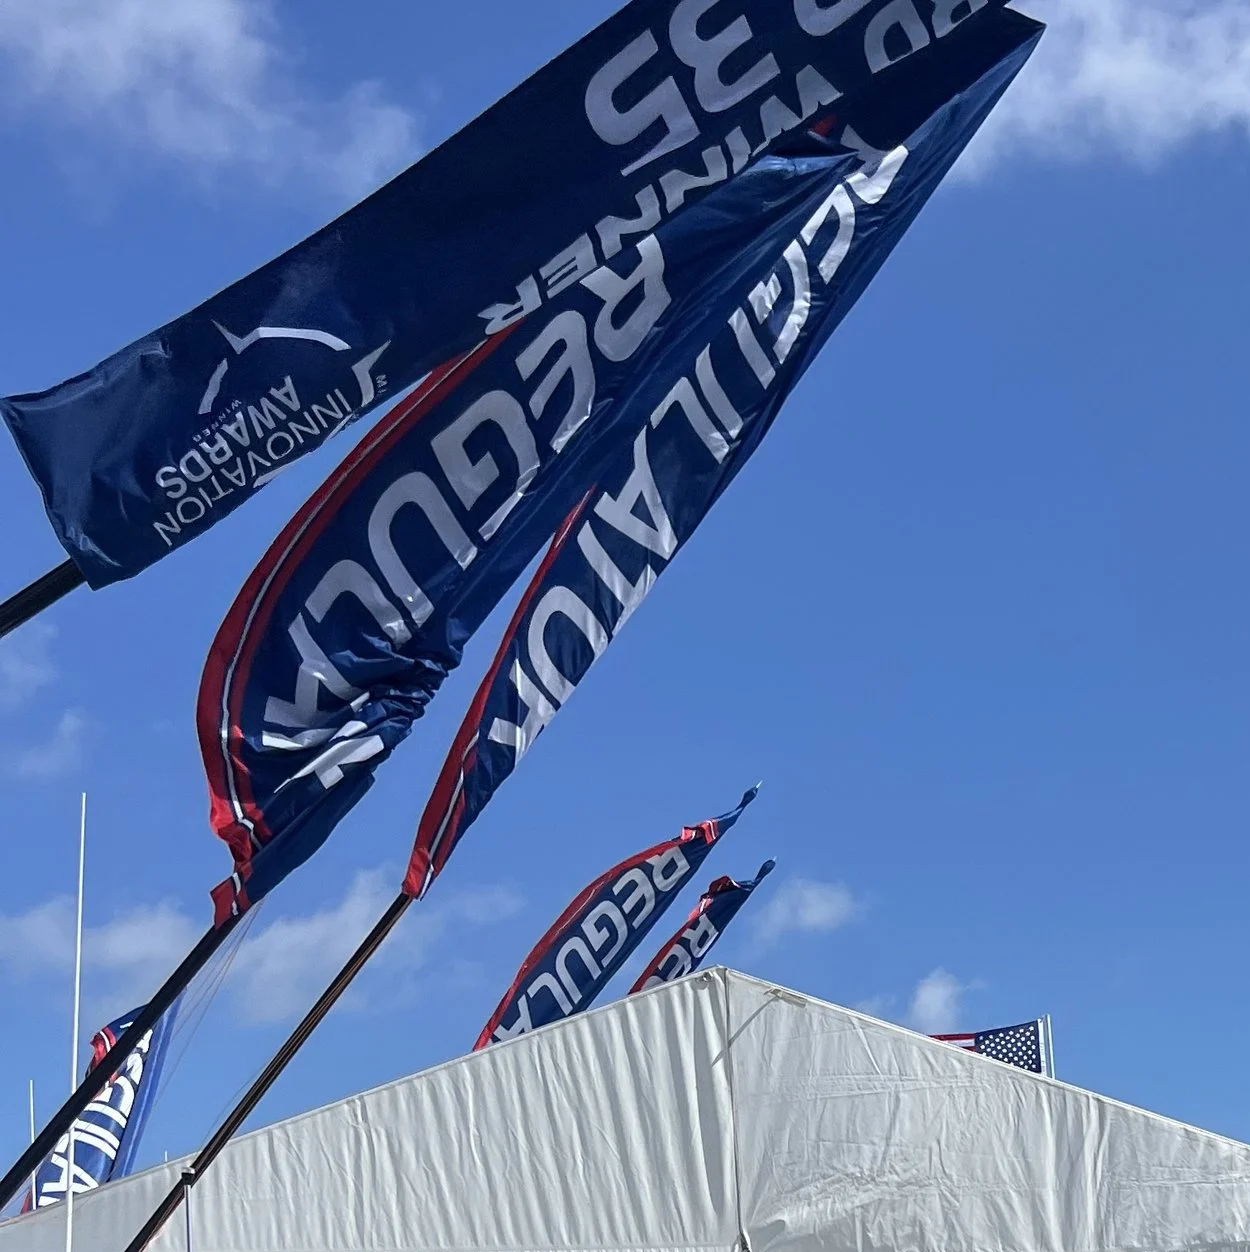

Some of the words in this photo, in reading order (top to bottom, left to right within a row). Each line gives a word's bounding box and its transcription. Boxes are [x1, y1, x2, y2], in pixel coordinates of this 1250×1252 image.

[585, 0, 780, 176] 35
[478, 65, 843, 336] WINNER
[153, 388, 352, 547] INNOVATION
[155, 375, 300, 498] AWARDS
[192, 400, 242, 442] WINNER
